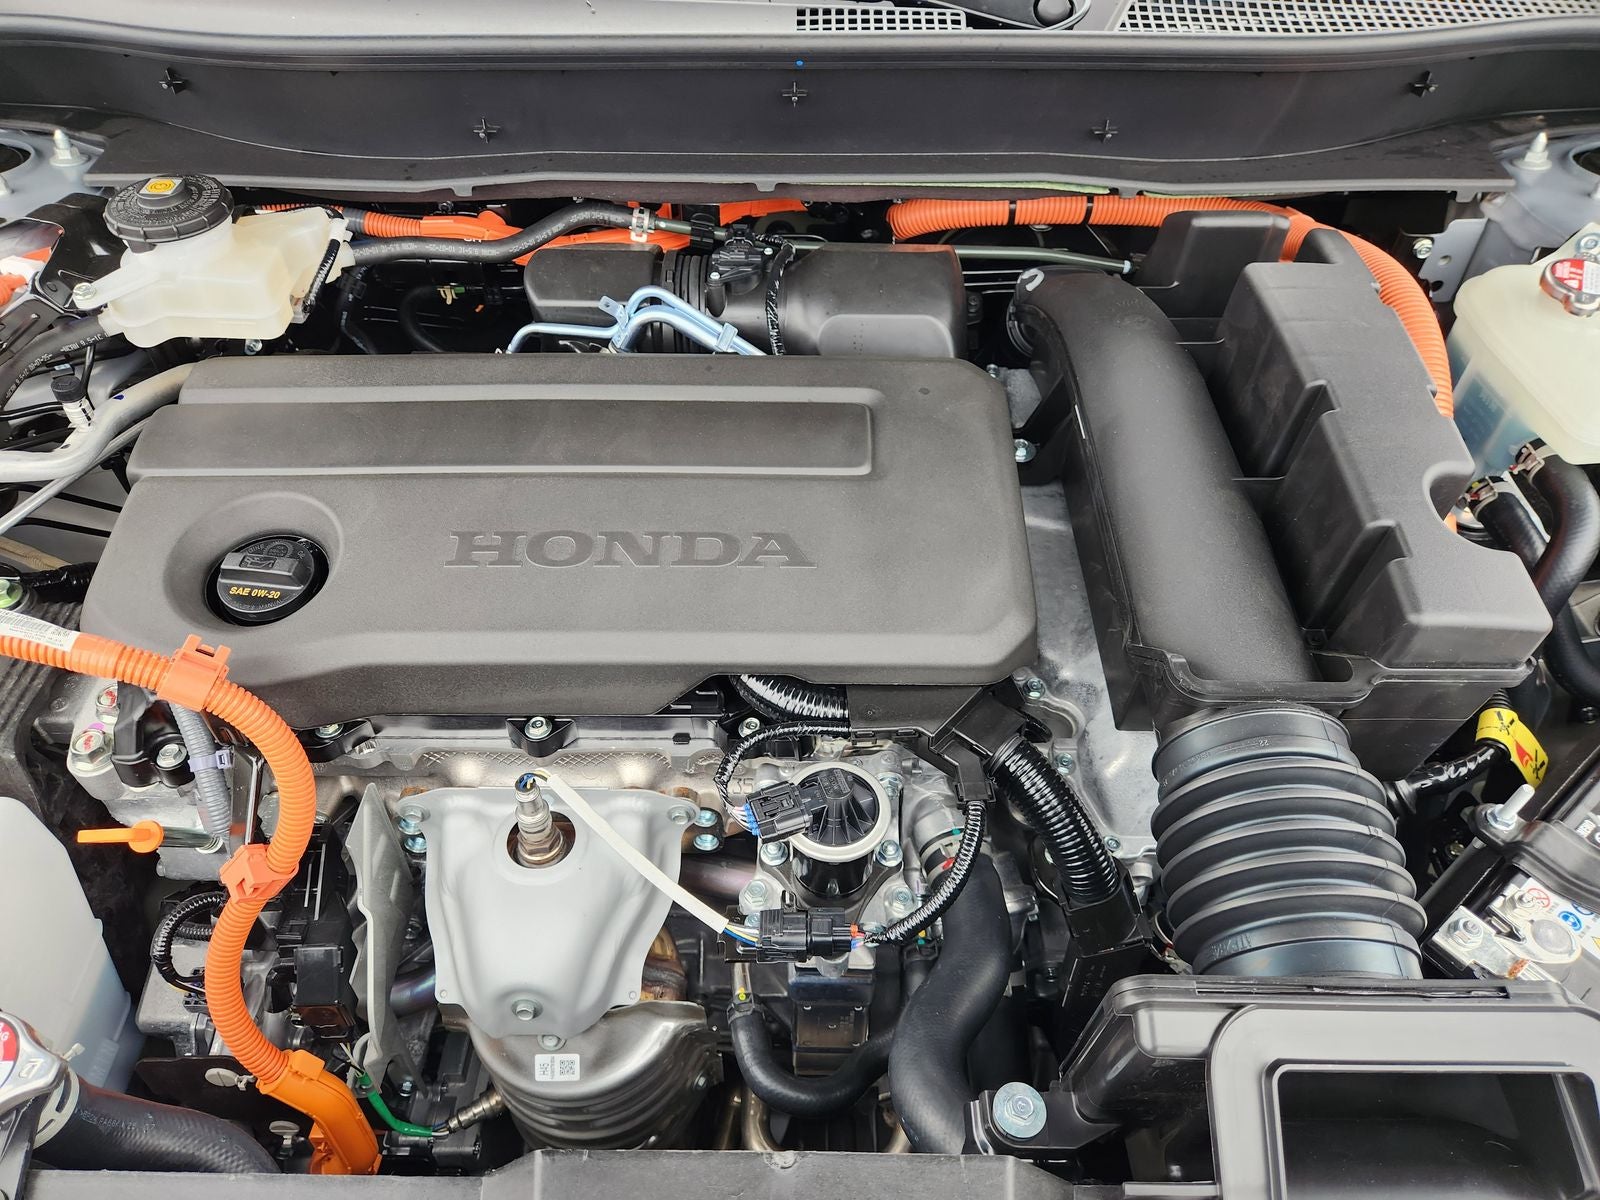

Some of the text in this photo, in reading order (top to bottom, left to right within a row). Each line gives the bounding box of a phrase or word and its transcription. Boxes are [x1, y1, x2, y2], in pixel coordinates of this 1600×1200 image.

[442, 530, 818, 570] HONDA
[229, 586, 281, 600] SAE 0W-20
